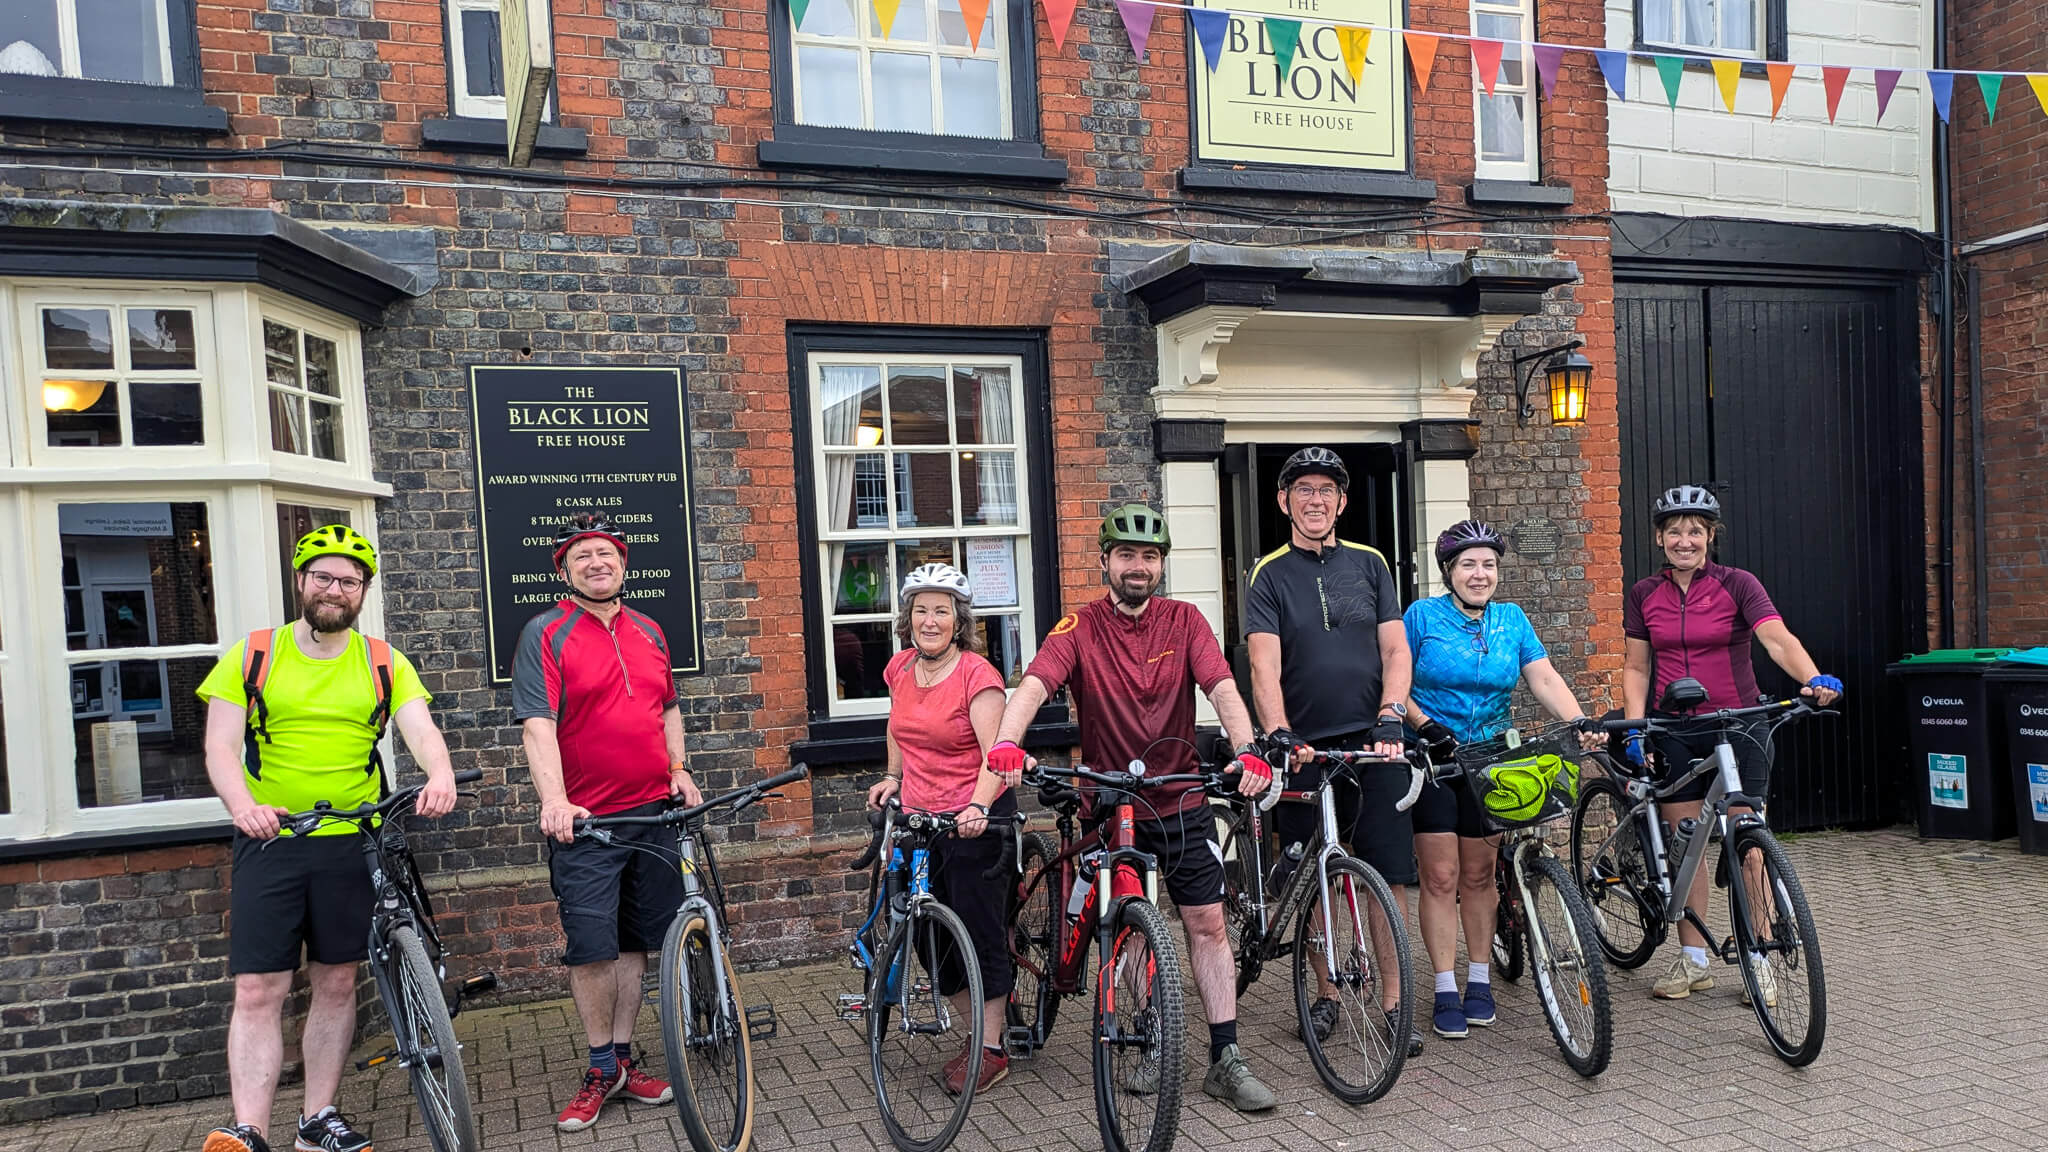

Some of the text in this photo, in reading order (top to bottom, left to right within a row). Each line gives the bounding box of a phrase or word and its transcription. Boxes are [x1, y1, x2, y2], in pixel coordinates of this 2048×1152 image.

[1288, 0, 1319, 11] THE
[1245, 60, 1358, 104] LION
[1253, 110, 1354, 131] FREE HOUSE
[564, 386, 595, 399] THE
[508, 408, 649, 425] BLACK LION
[537, 434, 626, 447] FREE HOUSE
[488, 473, 678, 485] AWARD WINNING 17TH CENTURY PUB
[555, 497, 622, 507] 8 CASK ALES
[531, 516, 537, 526] 8
[615, 514, 653, 524] CIDERS
[522, 533, 660, 547] OVER BEERS
[979, 564, 1001, 572] JULY
[511, 573, 546, 584] BRING
[641, 568, 671, 579] FOOD
[514, 593, 551, 604] LARGE
[1932, 698, 1964, 706] VEOLIA
[1936, 718, 1953, 726] 6060
[1953, 718, 1968, 726] 460
[2019, 727, 2035, 736] 0345
